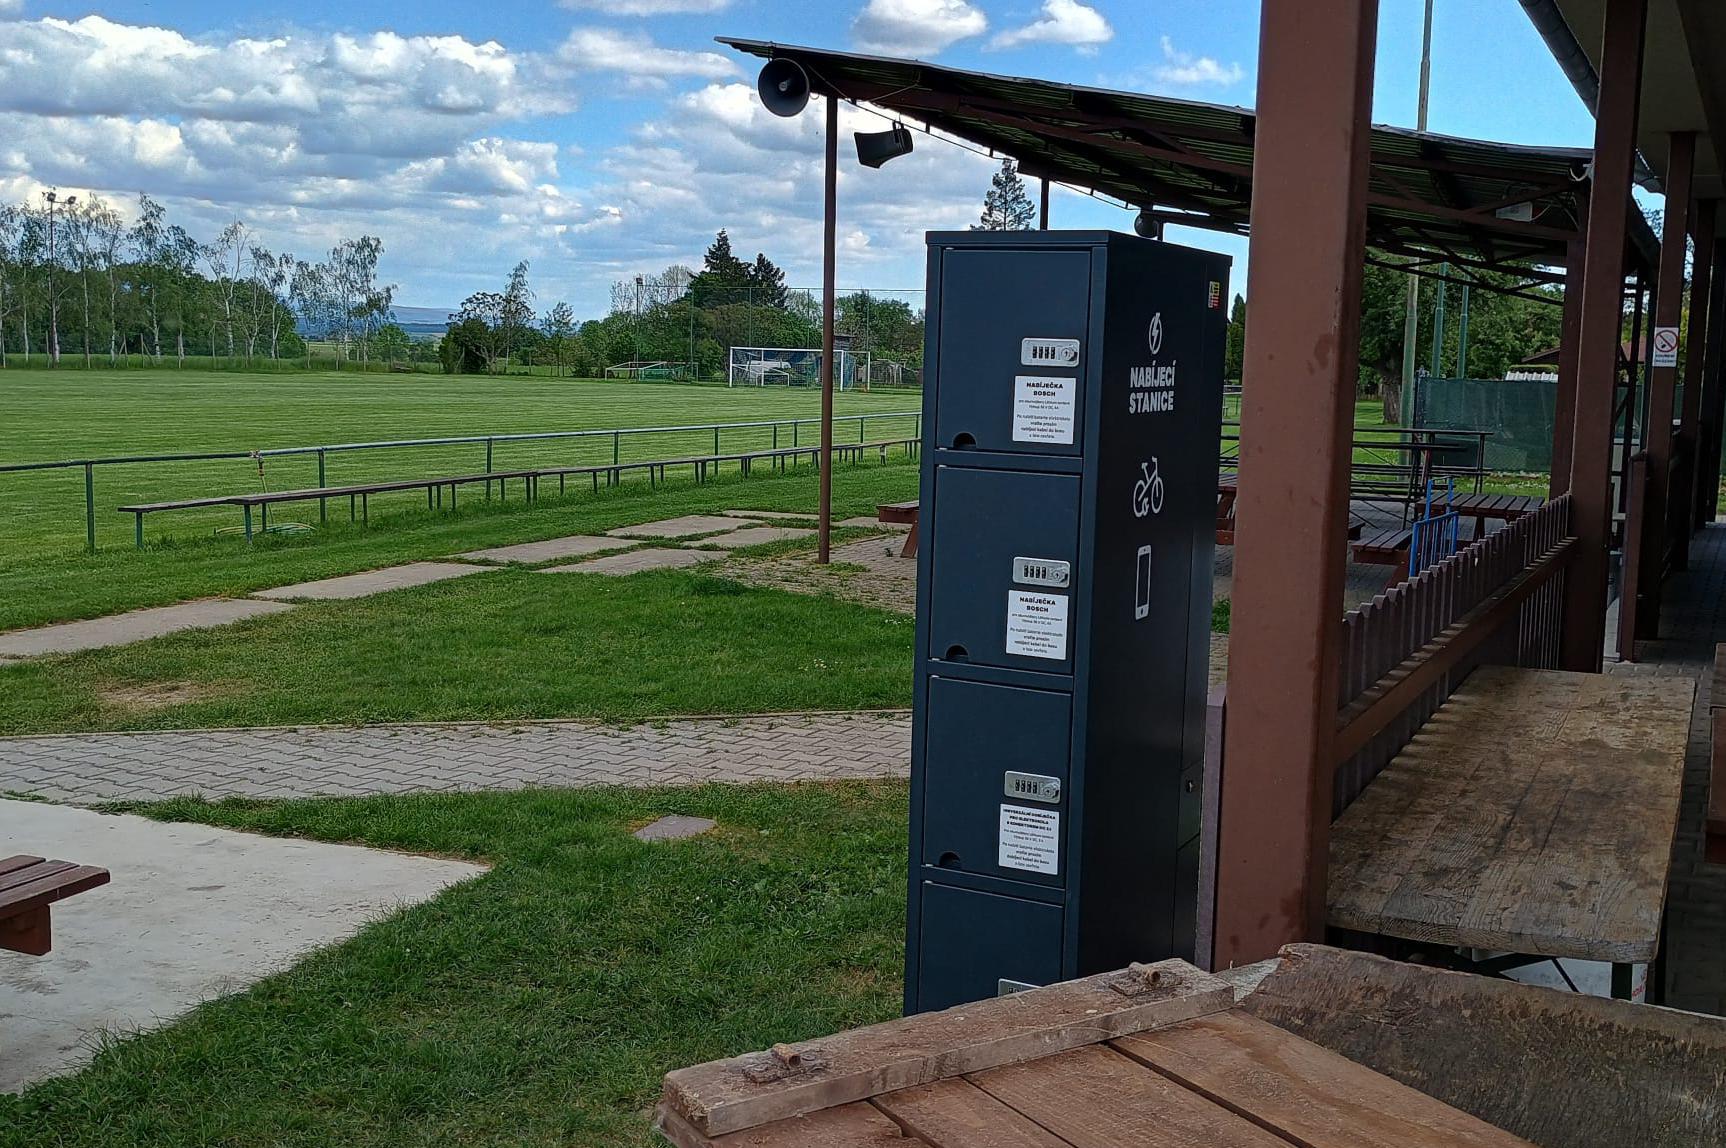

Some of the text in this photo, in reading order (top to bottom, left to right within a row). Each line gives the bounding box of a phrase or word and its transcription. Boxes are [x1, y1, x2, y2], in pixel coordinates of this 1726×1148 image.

[1130, 360, 1176, 388] NABÍJECÍ
[1026, 381, 1064, 389] NABÍJEČKA
[1129, 391, 1175, 414] STANICE
[1019, 597, 1056, 606] NABÍJEČKA
[1026, 605, 1049, 613] BOSCH
